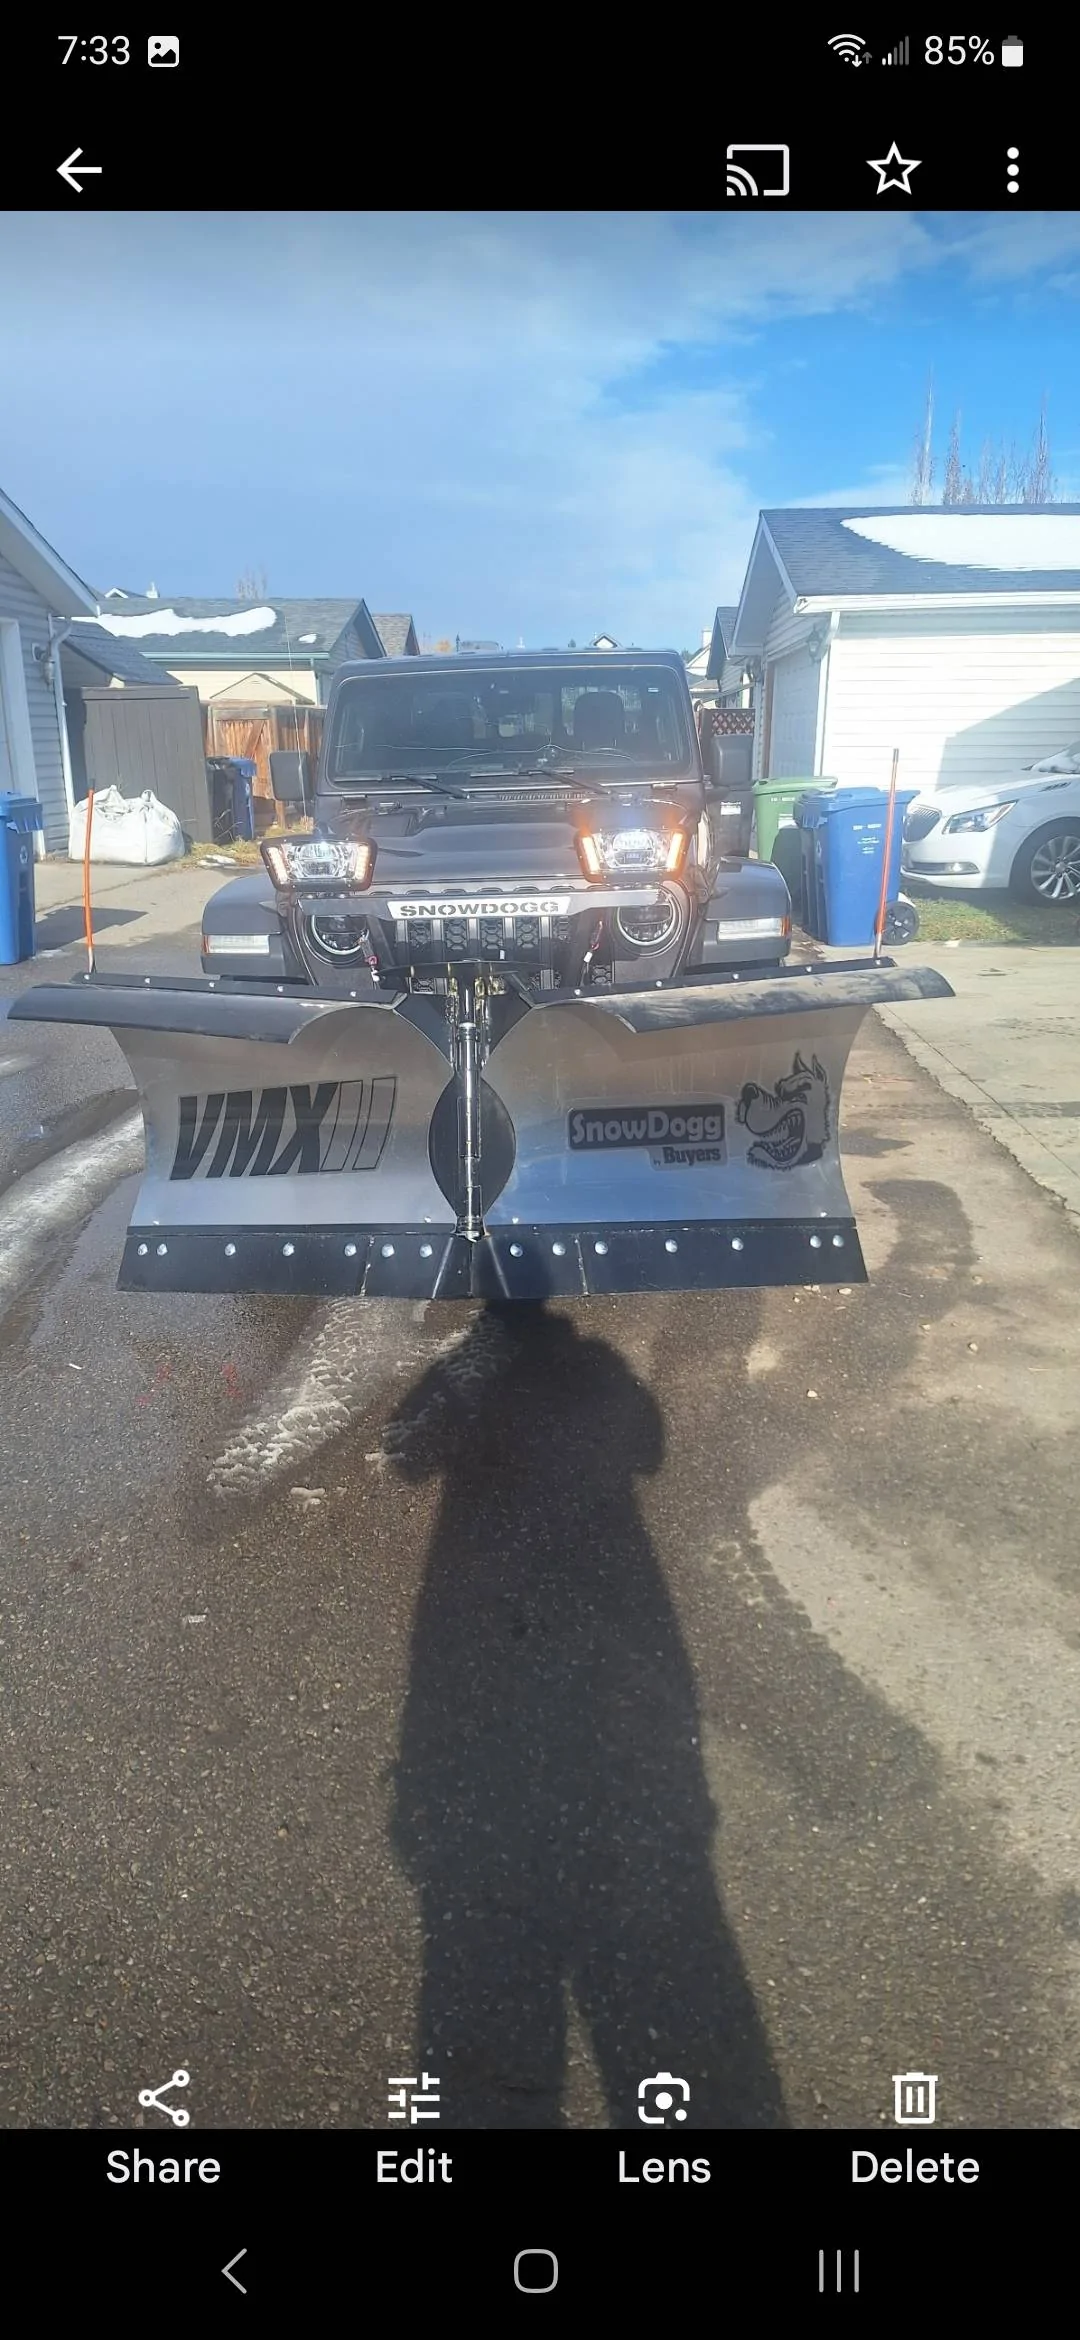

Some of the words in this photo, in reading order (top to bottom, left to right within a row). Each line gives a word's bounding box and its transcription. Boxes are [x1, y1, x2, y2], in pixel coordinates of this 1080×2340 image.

[399, 900, 560, 917] SNOWDOGG
[571, 1110, 723, 1144] SnowDogg
[662, 1146, 722, 1166] Buyers
